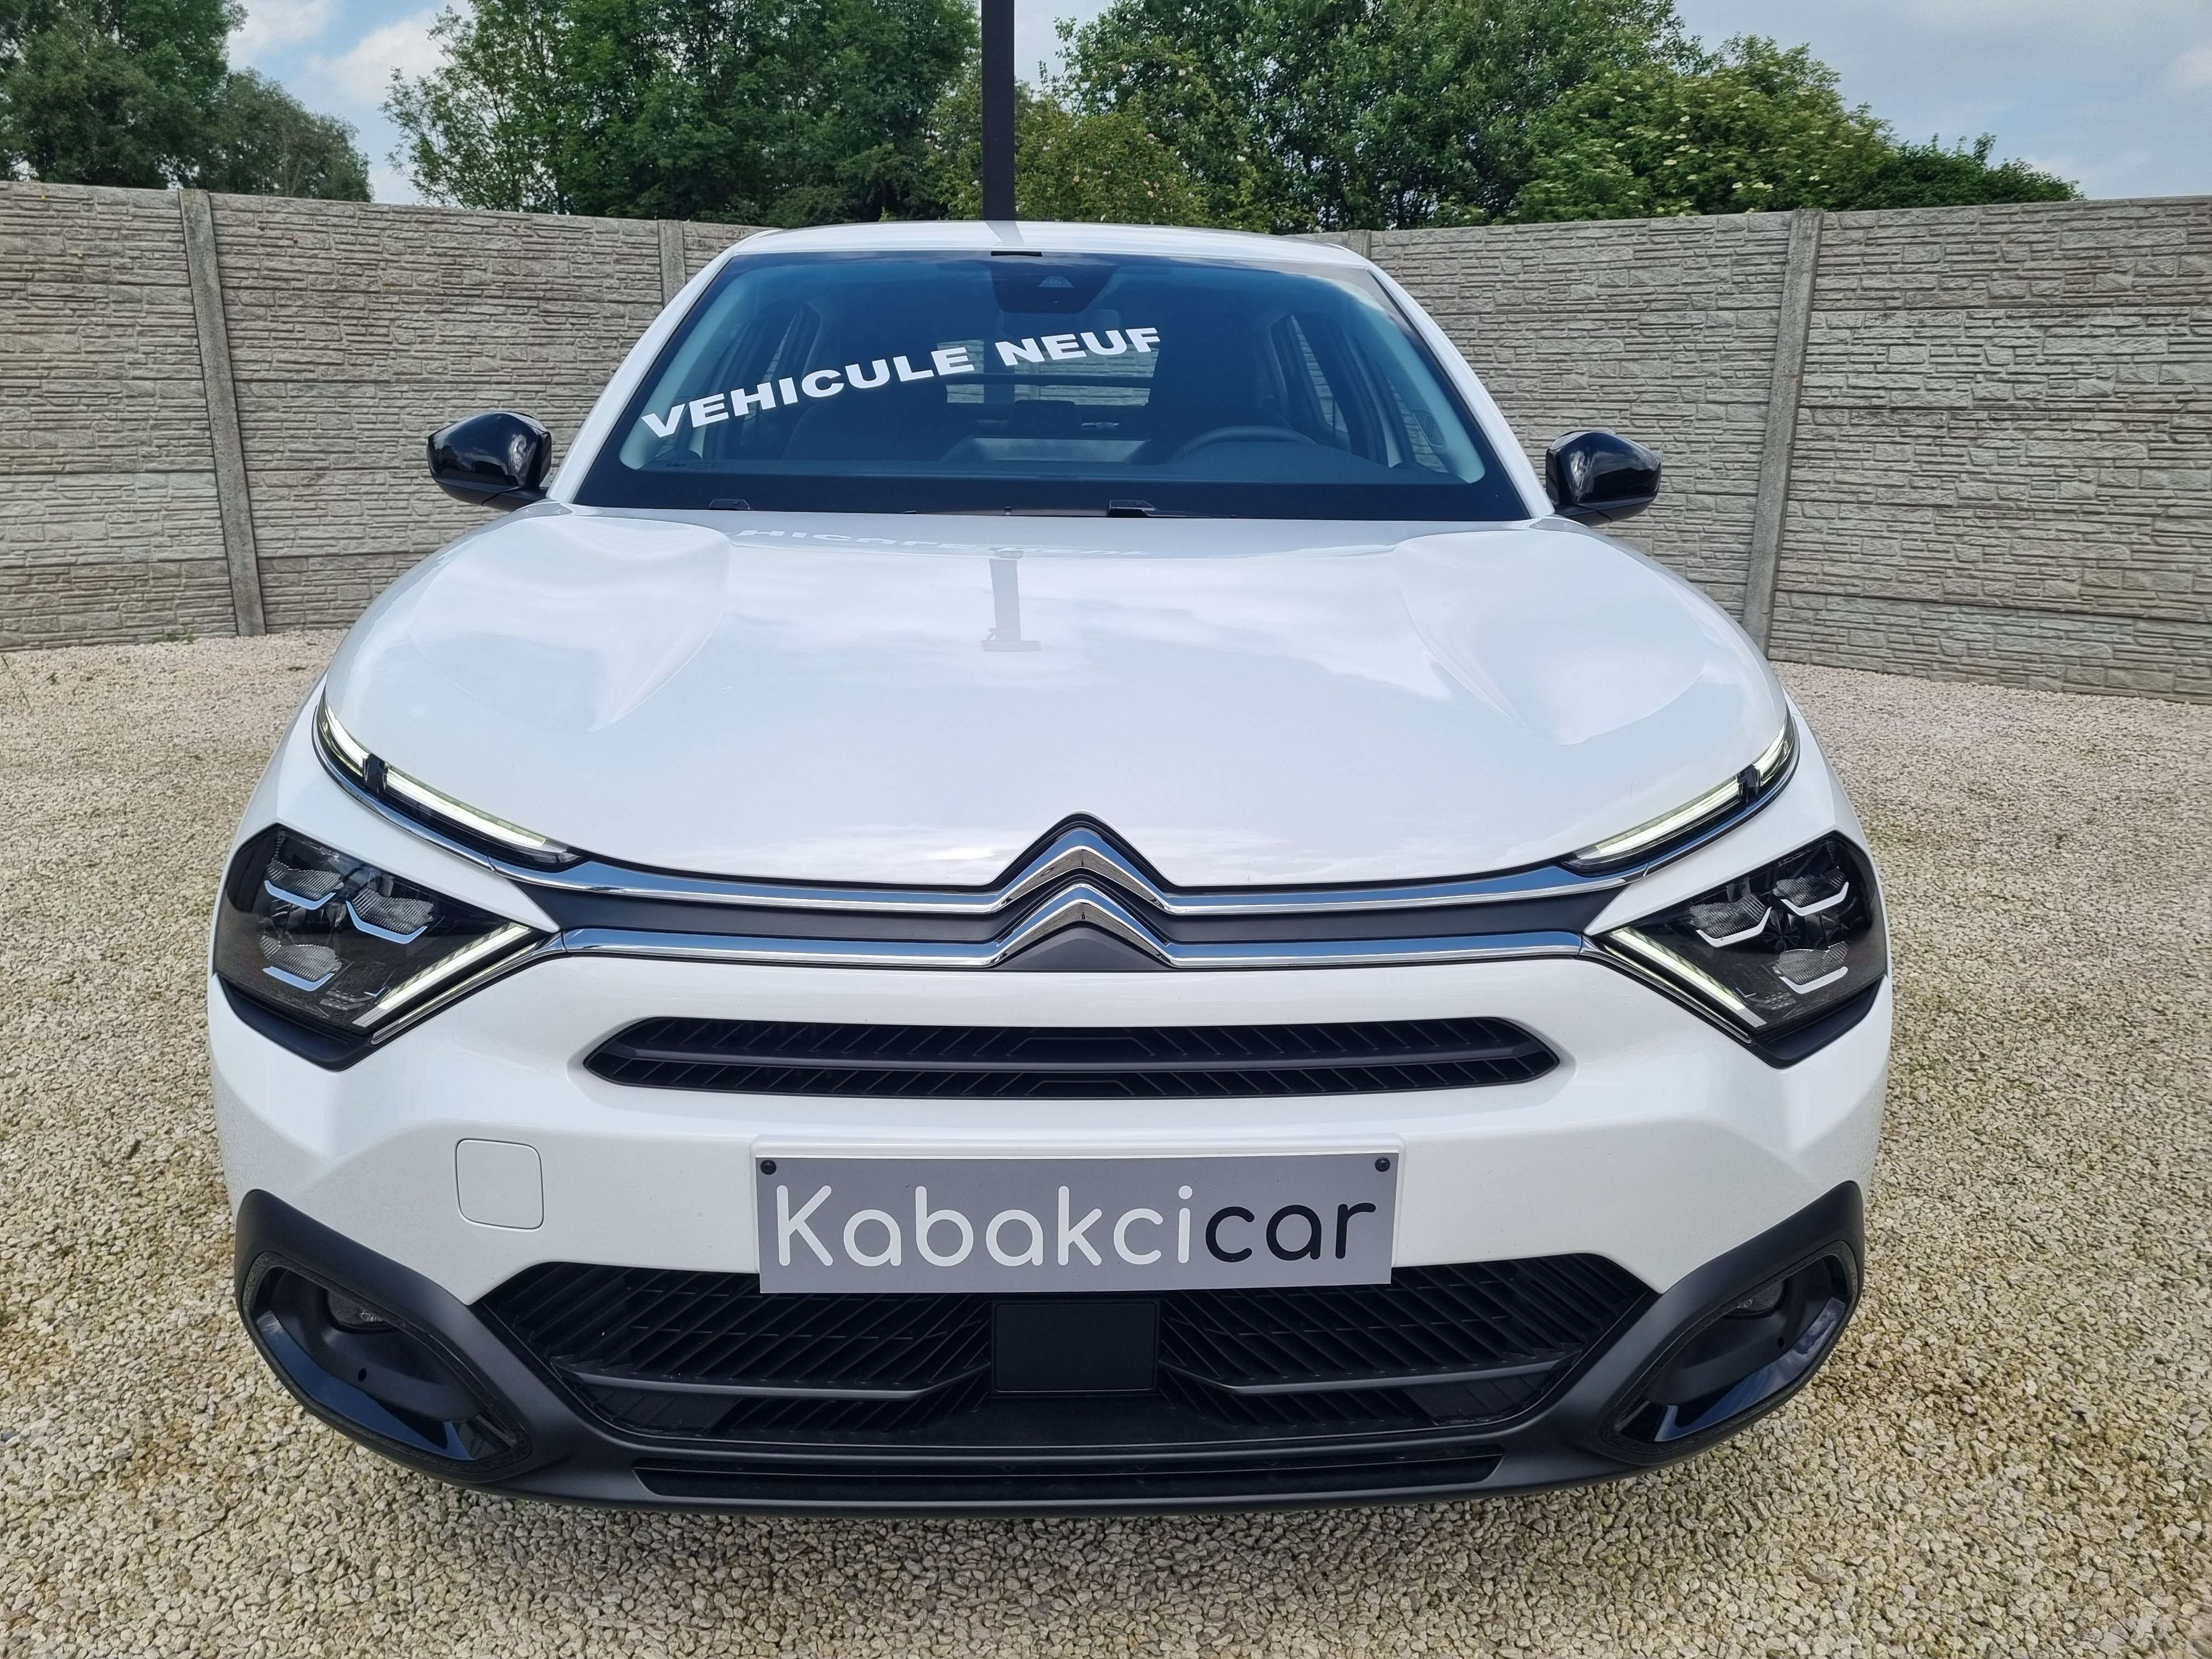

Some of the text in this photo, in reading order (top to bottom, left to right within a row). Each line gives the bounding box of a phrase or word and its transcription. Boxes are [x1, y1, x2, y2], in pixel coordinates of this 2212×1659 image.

[641, 328, 1161, 438] VEHICULE NEUF
[776, 1185, 1376, 1267] Kabakcicar
